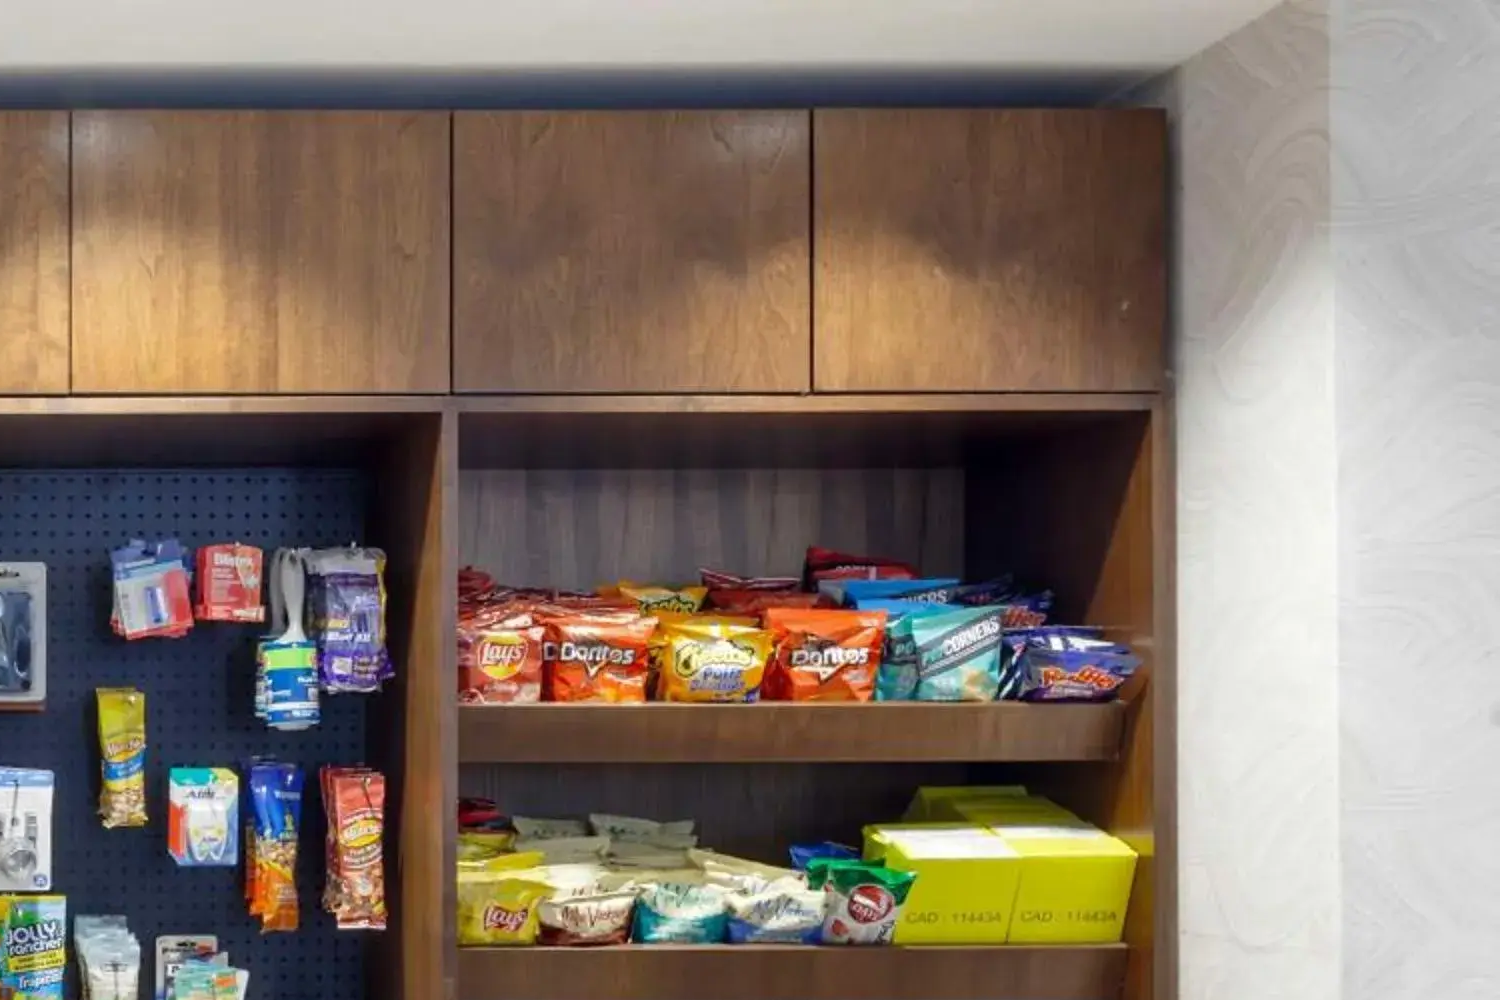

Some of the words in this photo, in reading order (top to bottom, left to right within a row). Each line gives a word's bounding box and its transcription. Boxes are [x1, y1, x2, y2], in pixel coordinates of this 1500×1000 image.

[942, 615, 1000, 655] CORNERS
[560, 641, 636, 666] Doritos
[791, 645, 869, 670] Doritos
[1041, 668, 1124, 691] Ruffles
[905, 911, 939, 924] CAD
[1020, 910, 1053, 922] CAD
[7, 921, 56, 946] JOLLY
